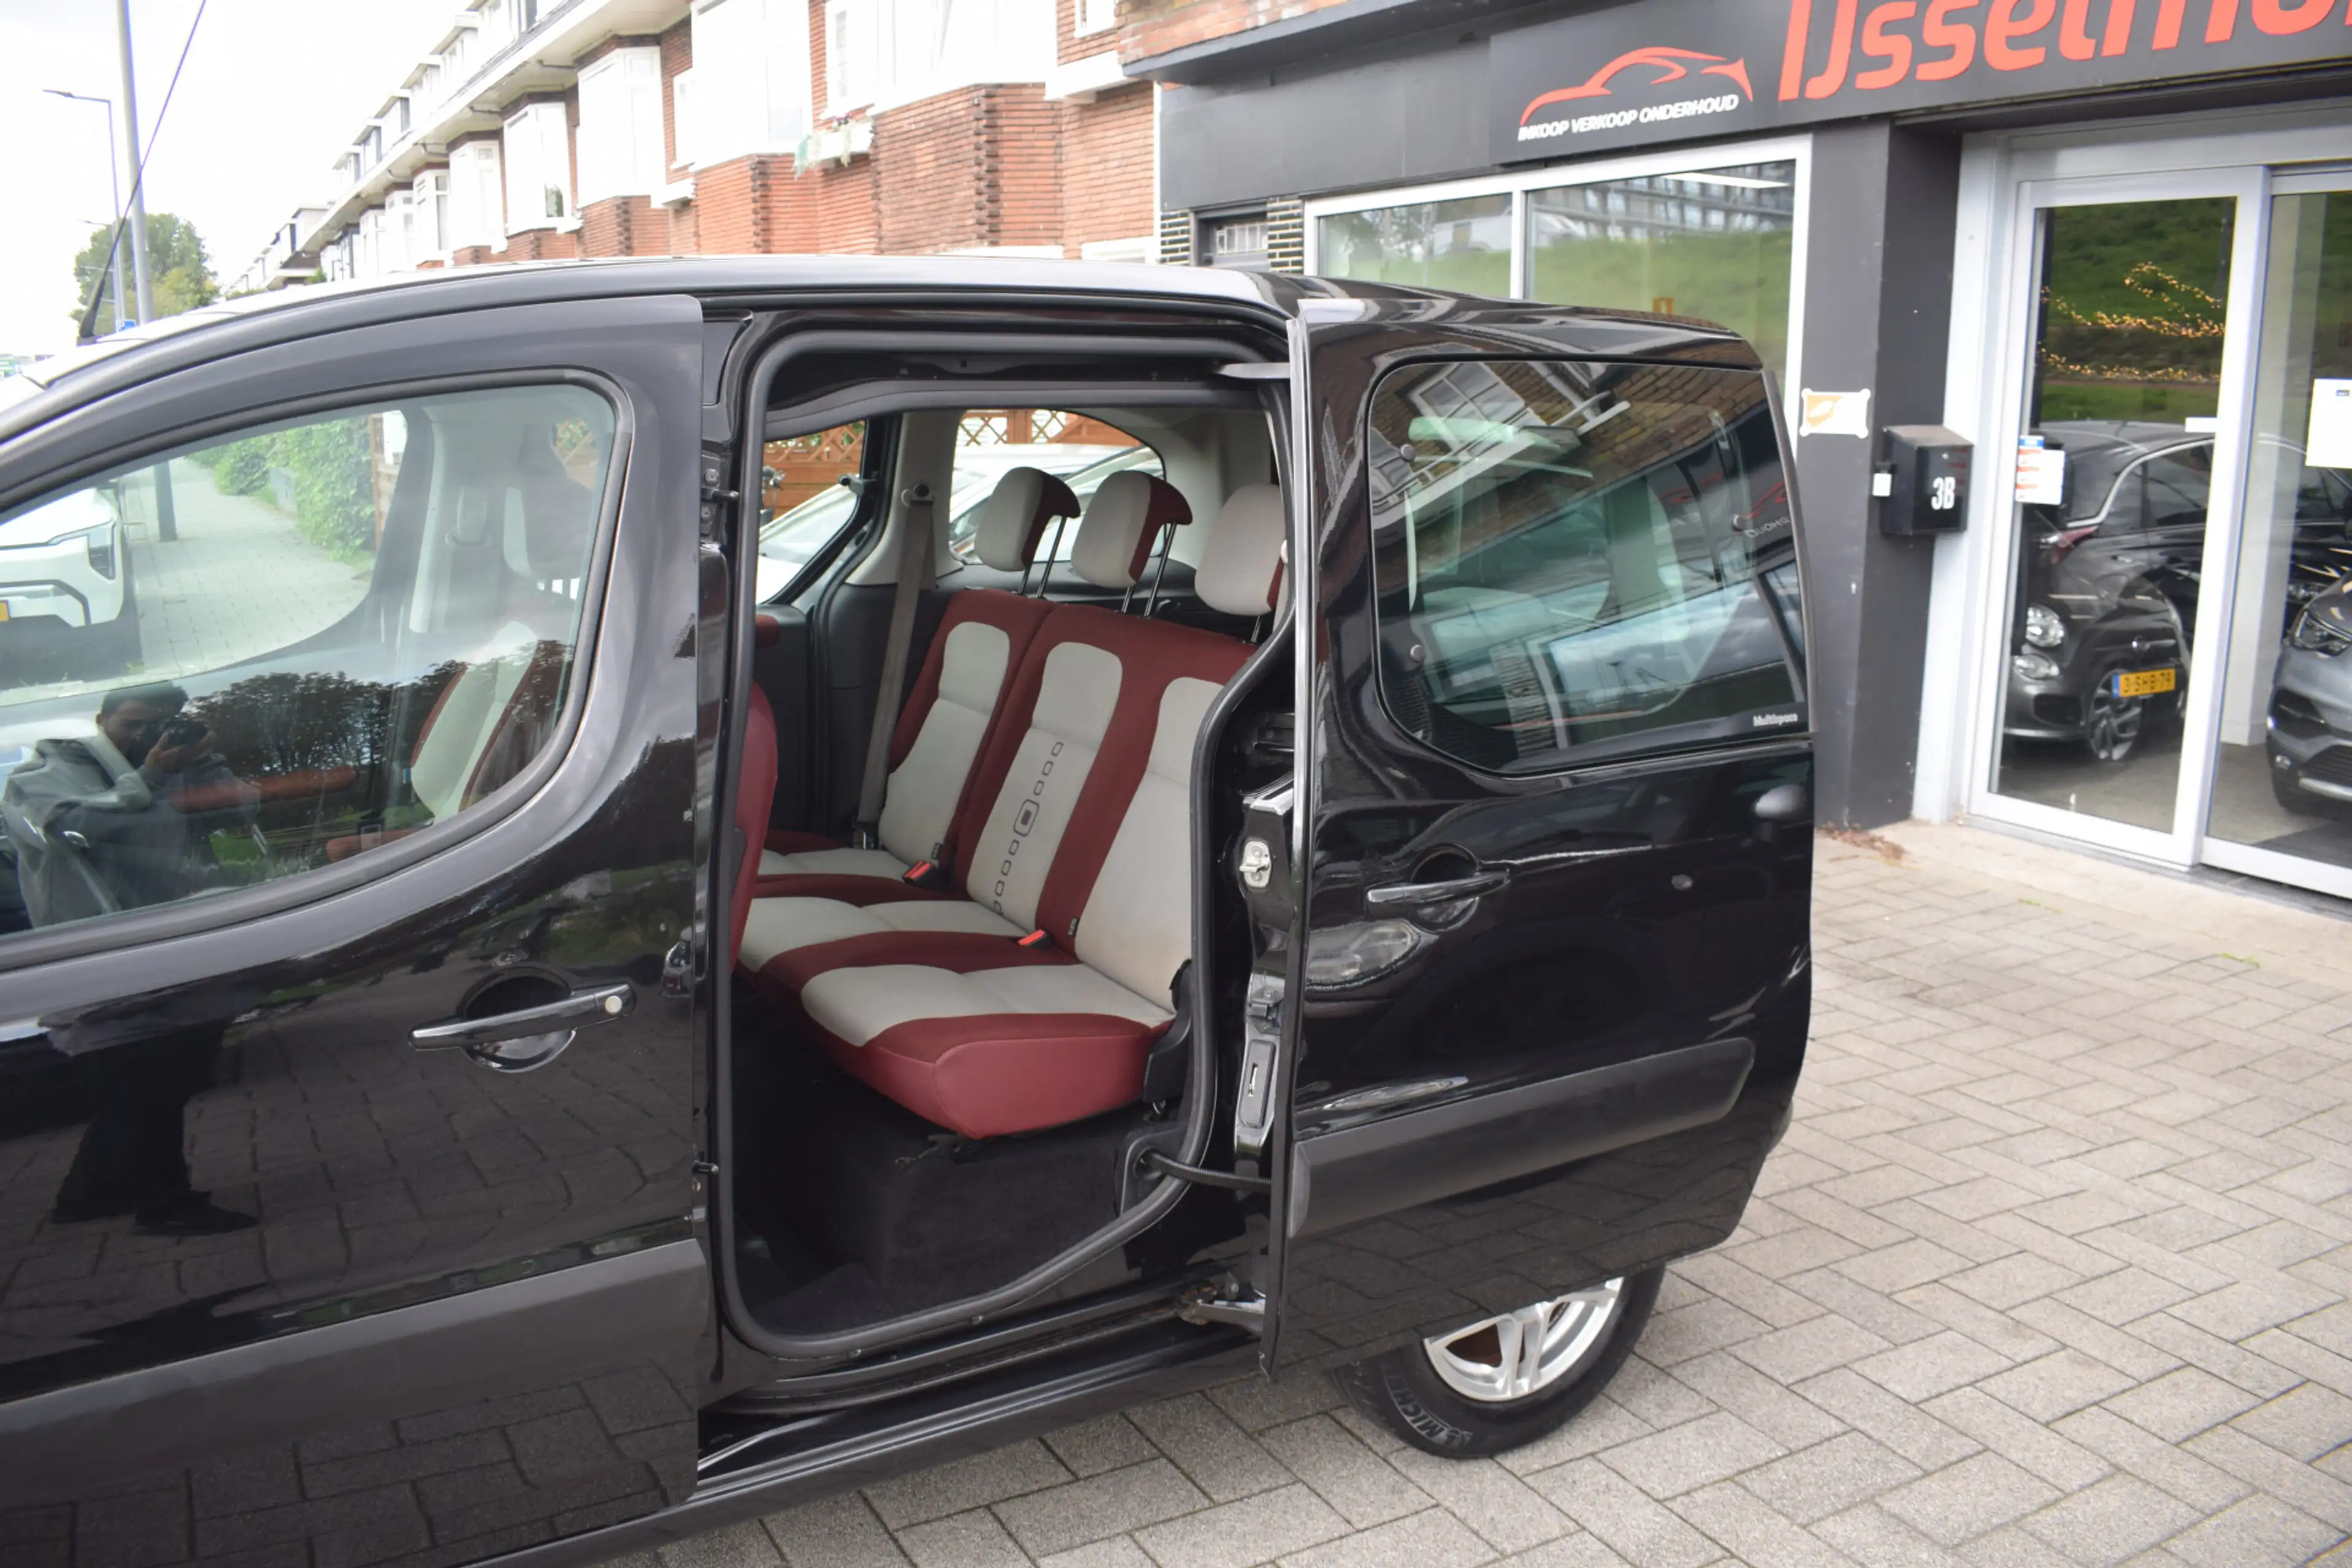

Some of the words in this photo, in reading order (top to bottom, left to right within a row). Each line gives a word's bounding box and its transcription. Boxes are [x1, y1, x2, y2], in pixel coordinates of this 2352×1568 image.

[1778, 0, 2352, 101] IJsselm
[1518, 121, 1570, 141] INKOOP
[1571, 109, 1638, 133] VERKOOP
[1639, 94, 1739, 123] ONDERHOUD
[1931, 477, 1955, 510] 3B
